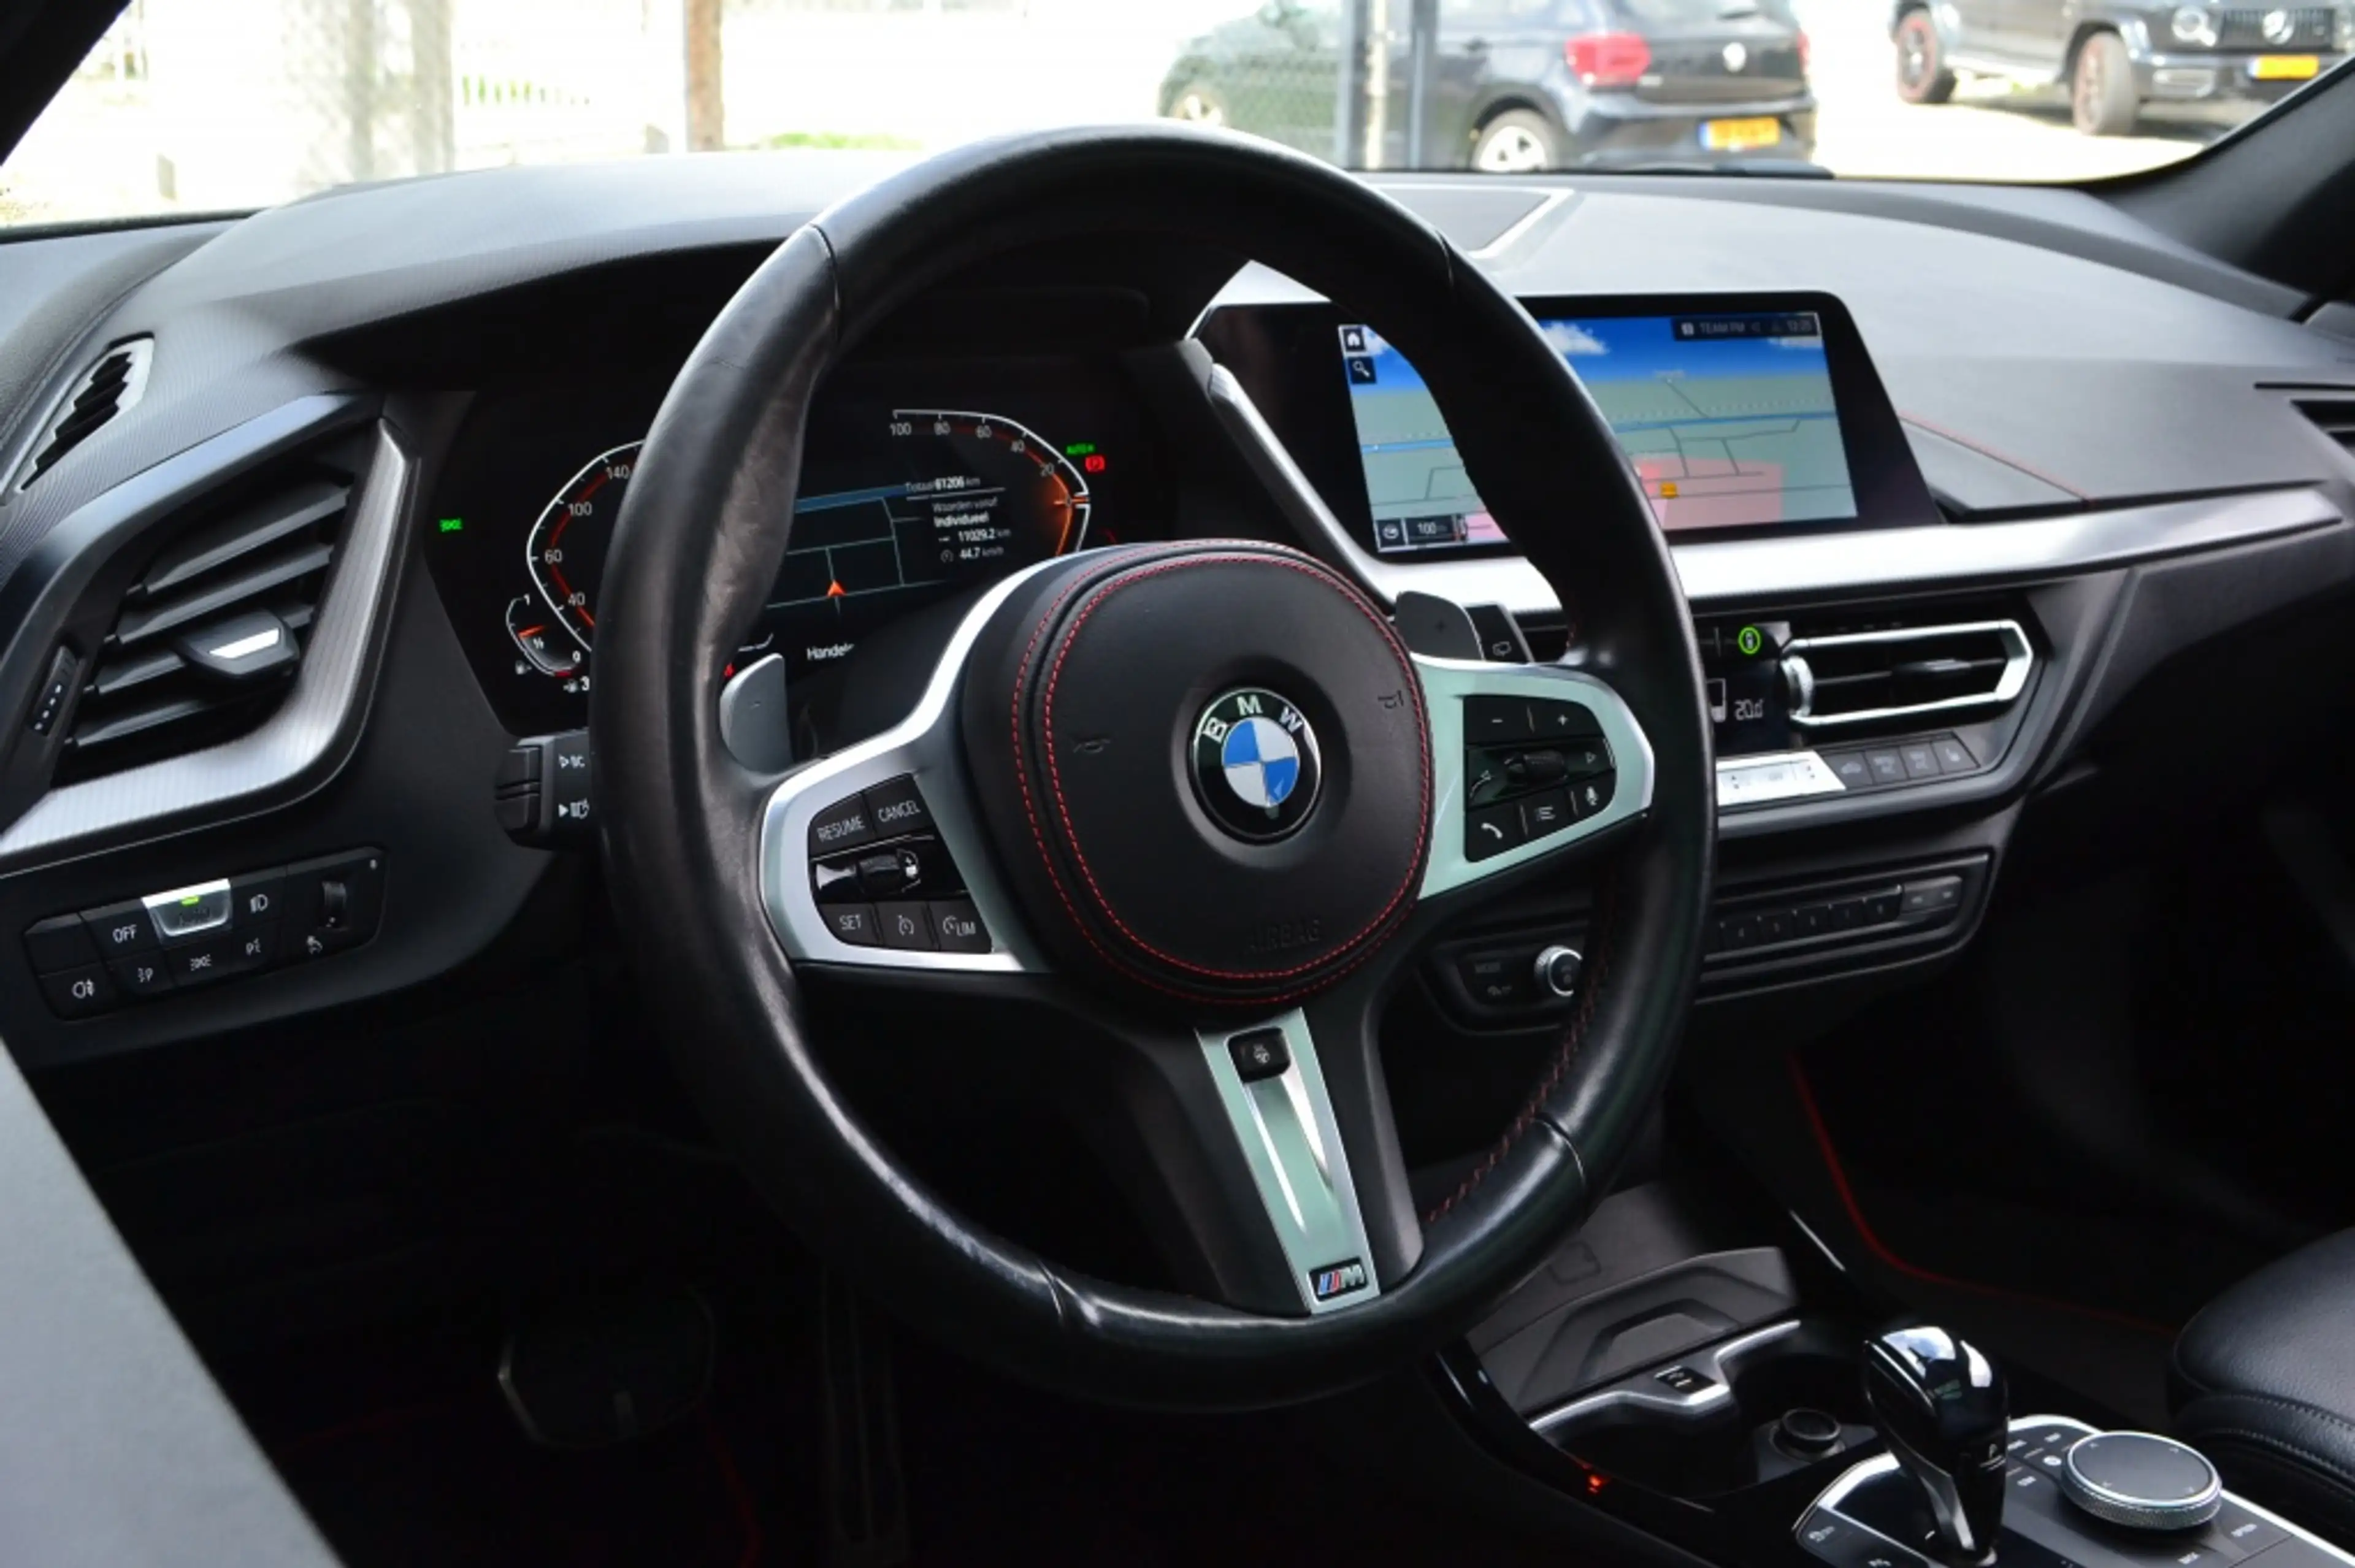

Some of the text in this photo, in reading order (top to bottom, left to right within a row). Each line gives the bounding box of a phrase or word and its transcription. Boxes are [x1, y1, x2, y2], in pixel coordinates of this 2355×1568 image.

[889, 423, 912, 435] 100
[934, 421, 951, 435] 80
[976, 424, 992, 438] 60
[1011, 440, 1026, 452] 40
[605, 467, 629, 480] 140
[1040, 462, 1055, 476] 20
[568, 501, 592, 516] 100
[545, 548, 562, 564] 60
[568, 591, 585, 606] 40
[1201, 694, 1303, 744] BMW
[877, 799, 922, 823] CANCEL
[816, 815, 866, 843] RESUME
[838, 914, 862, 931] SET
[956, 920, 976, 937] LIM
[112, 924, 137, 943] OFF
